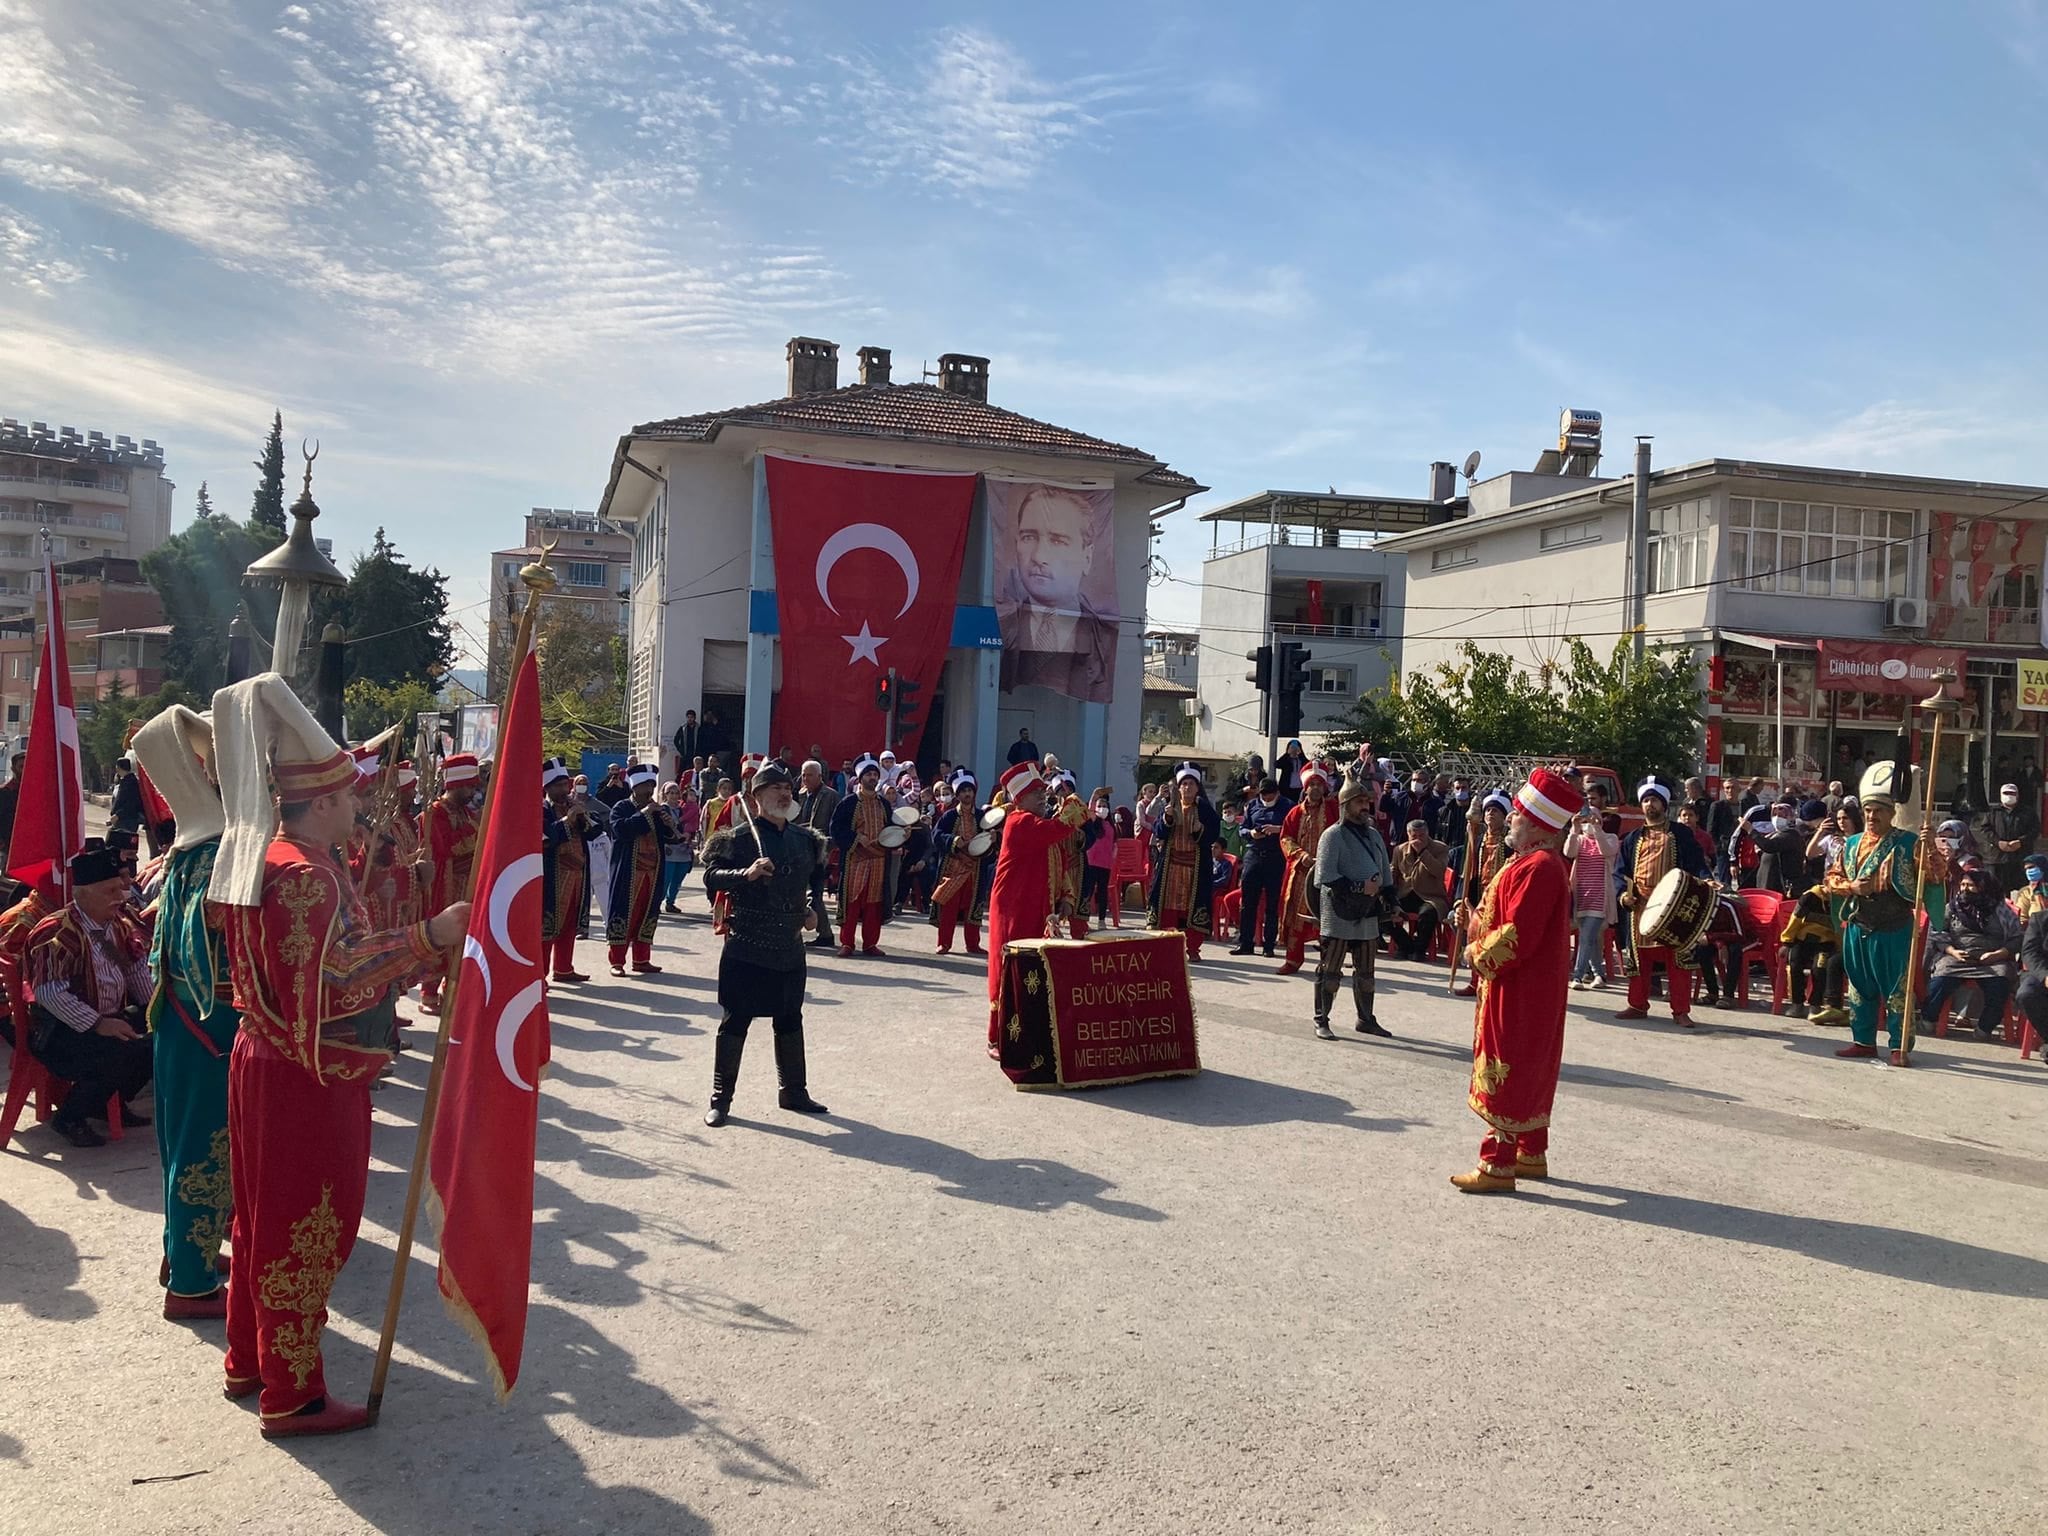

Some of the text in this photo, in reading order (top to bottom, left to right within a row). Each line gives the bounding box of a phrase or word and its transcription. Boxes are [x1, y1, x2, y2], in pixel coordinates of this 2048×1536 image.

[2023, 670, 2048, 685] YA
[1091, 952, 1151, 974] HATAY
[1071, 978, 1173, 1007] BÜYÜKŞEHİR
[1077, 1012, 1176, 1040] BELEDİYESİ
